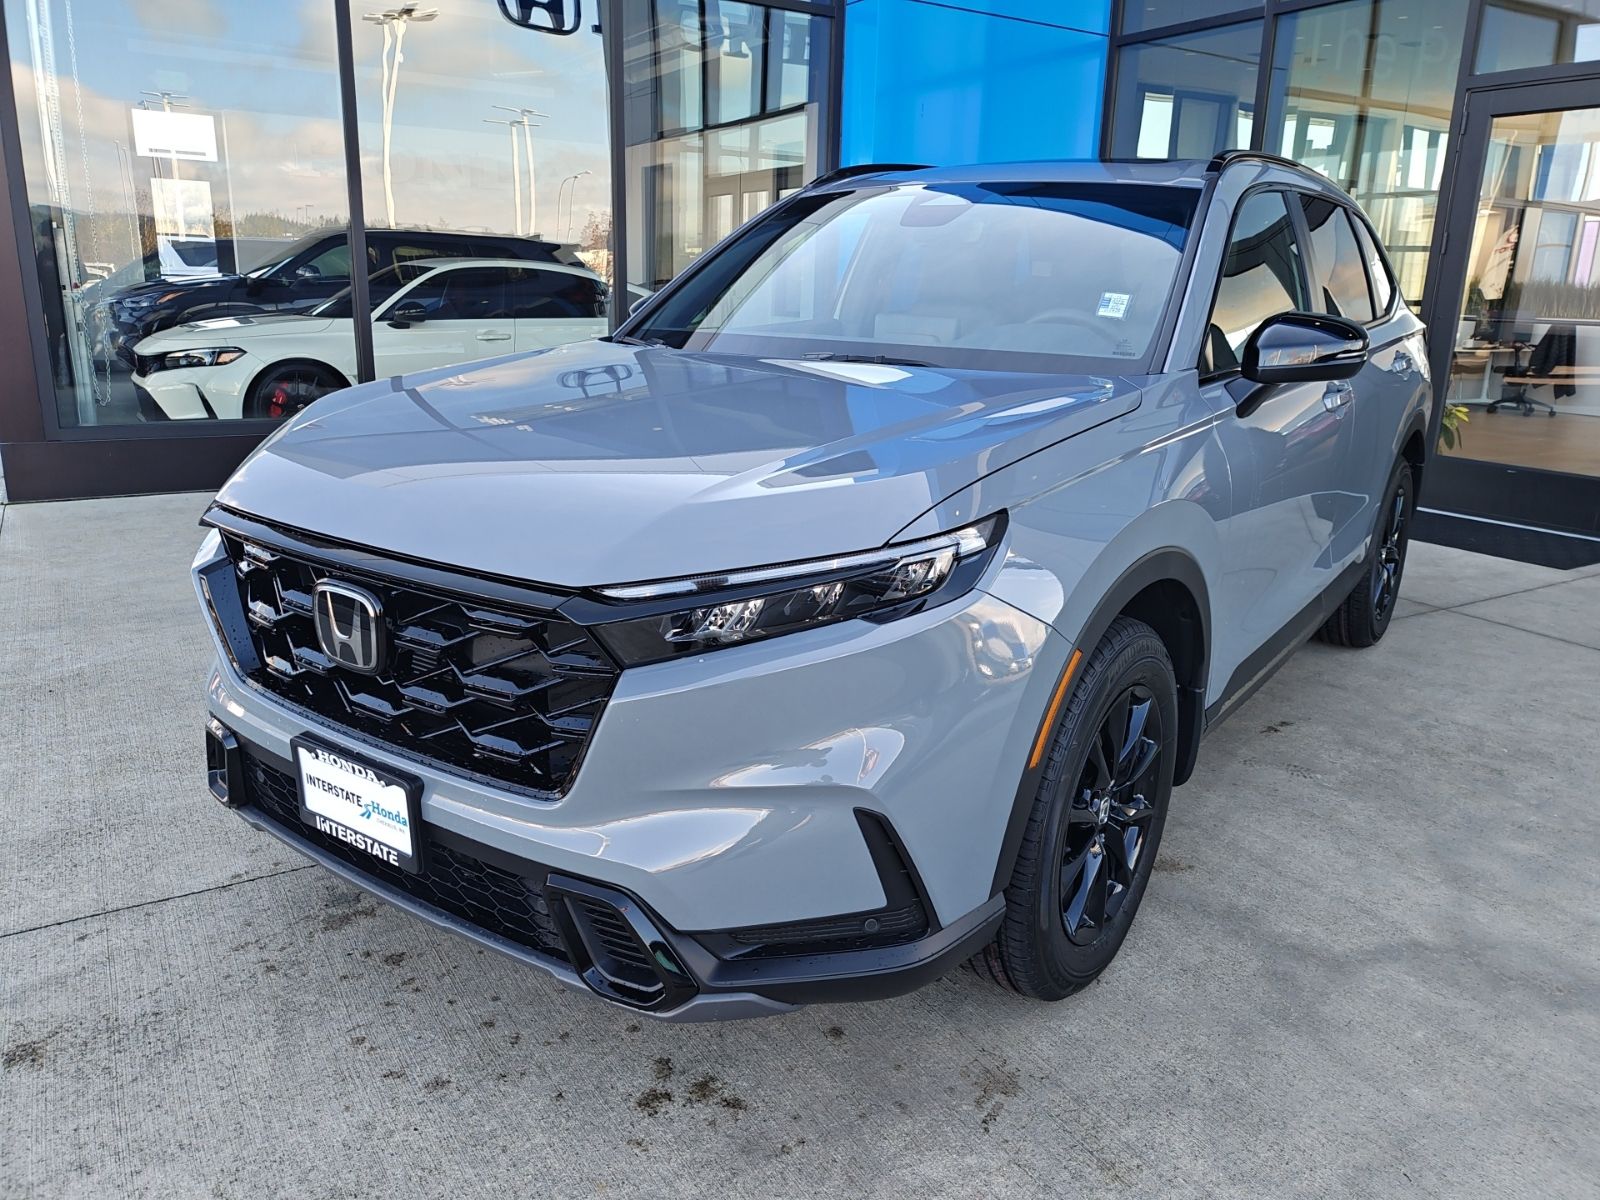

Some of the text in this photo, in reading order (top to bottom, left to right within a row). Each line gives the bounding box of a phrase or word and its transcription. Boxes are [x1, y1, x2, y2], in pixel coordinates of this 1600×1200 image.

[315, 748, 380, 783] HONDA
[306, 772, 363, 808] INTERSTATE
[370, 800, 408, 827] Honda
[316, 816, 398, 866] INTERSTATE
